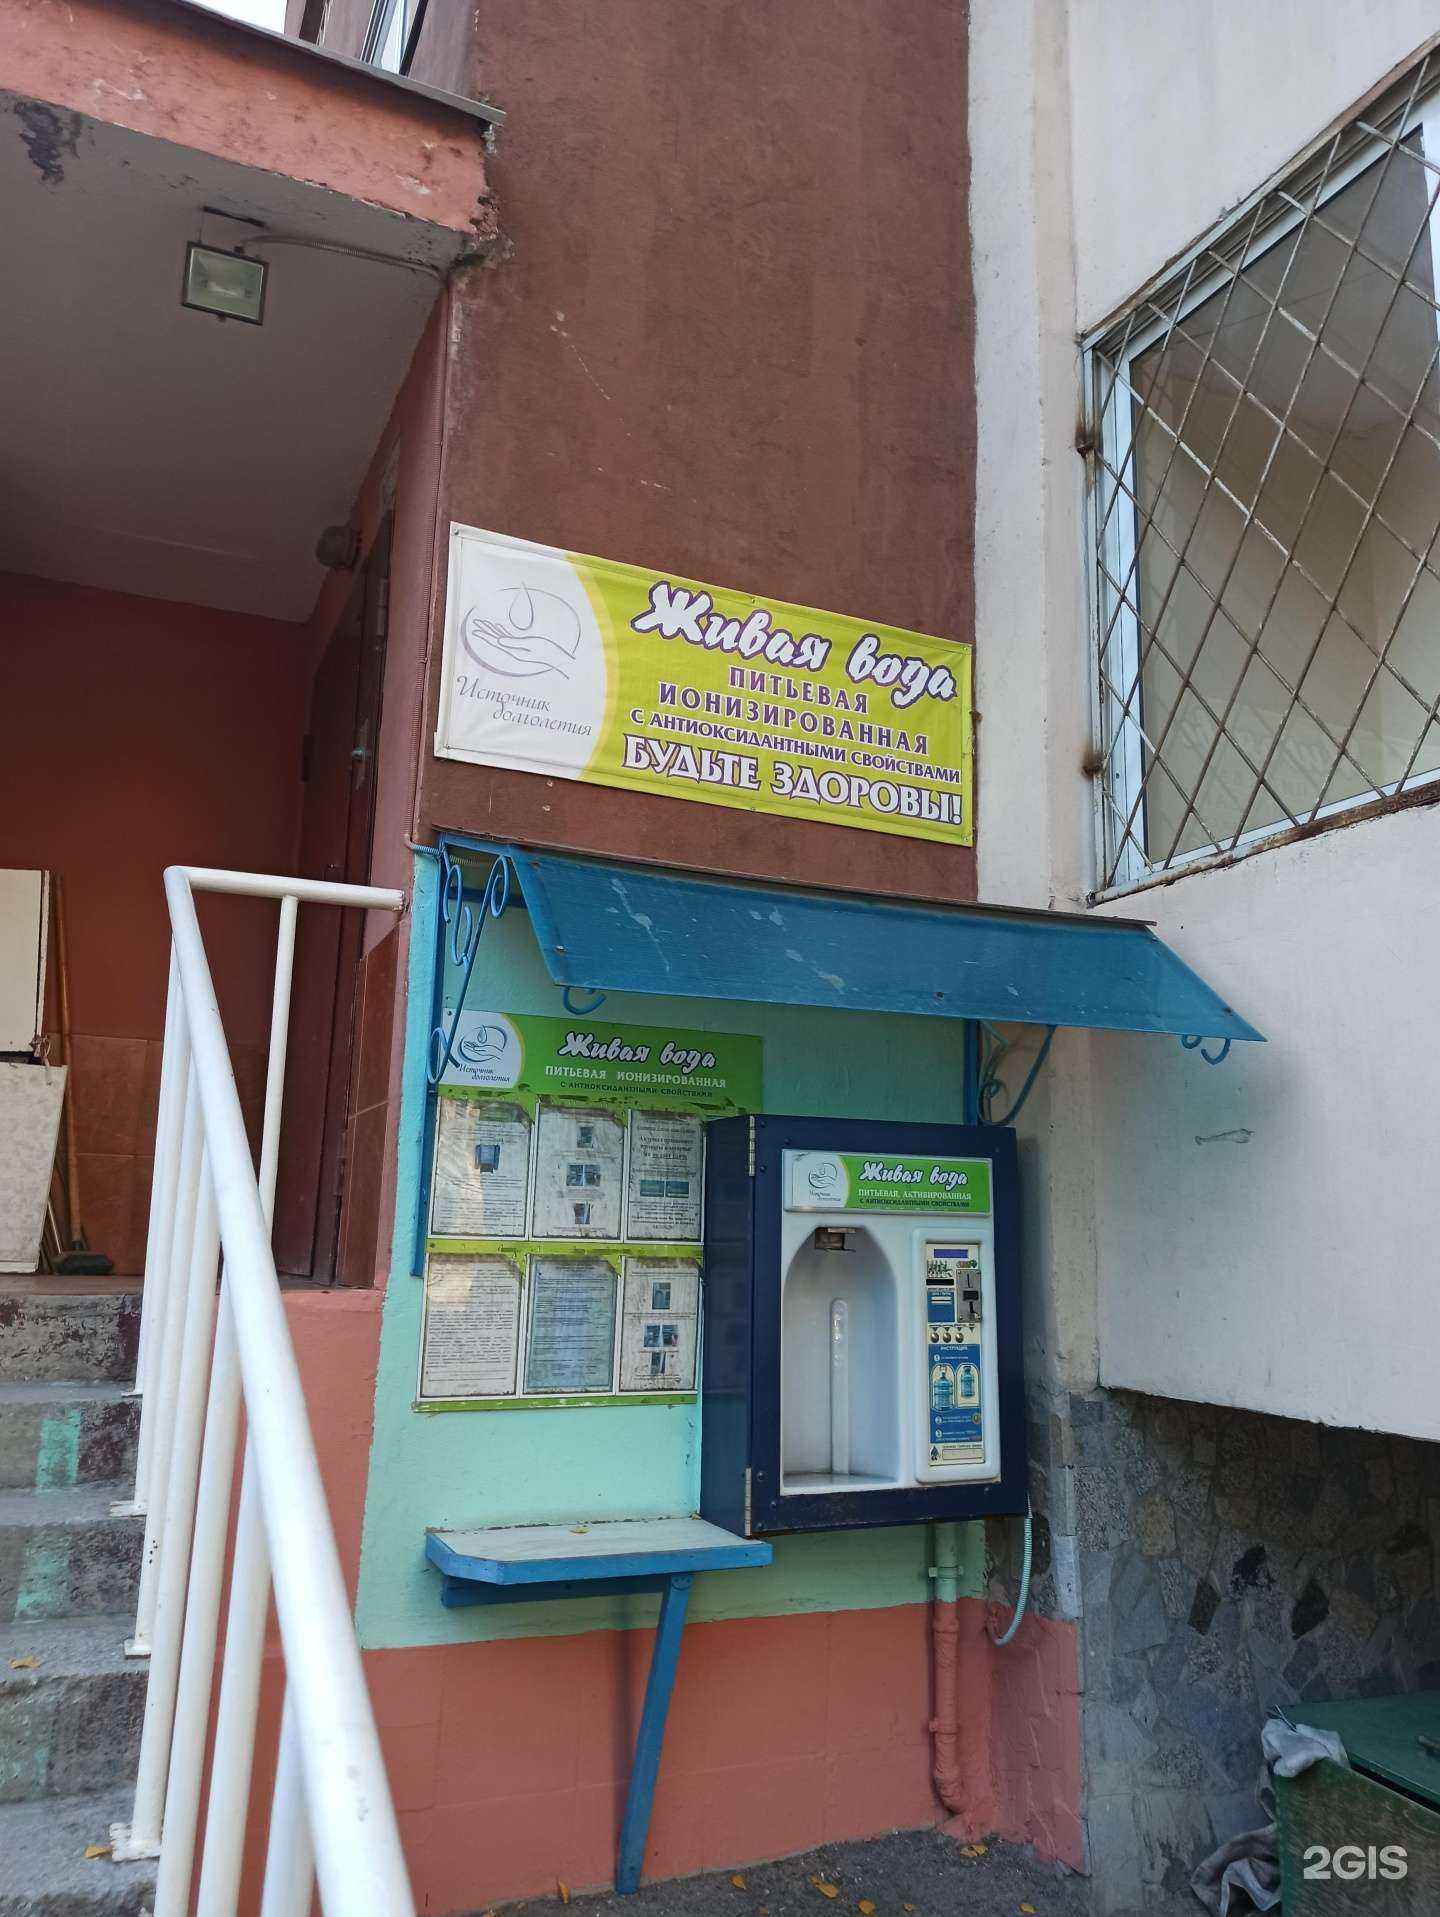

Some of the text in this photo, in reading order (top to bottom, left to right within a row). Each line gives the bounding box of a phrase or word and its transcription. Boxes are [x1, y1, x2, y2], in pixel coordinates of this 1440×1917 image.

[630, 580, 957, 710] Живая вода
[456, 675, 552, 713] Источник
[728, 666, 869, 714] ПИТЬЕВАЯ
[493, 700, 593, 736] долголетия
[658, 682, 930, 756] ИОНИЗИРОВАННАЯ
[649, 713, 847, 764] АНТИОКСИДАНТНЫМИ
[850, 747, 961, 784] СВОЙСТВАМИ
[622, 733, 964, 826] БУДЬТЕ ЗДОРОВЫ!
[557, 1031, 717, 1075] Живая вода
[544, 1064, 727, 1089] ПИТЬЕВАЯ ИОНИЗИРОВАННАЯ
[858, 1160, 968, 1191] Живая вода
